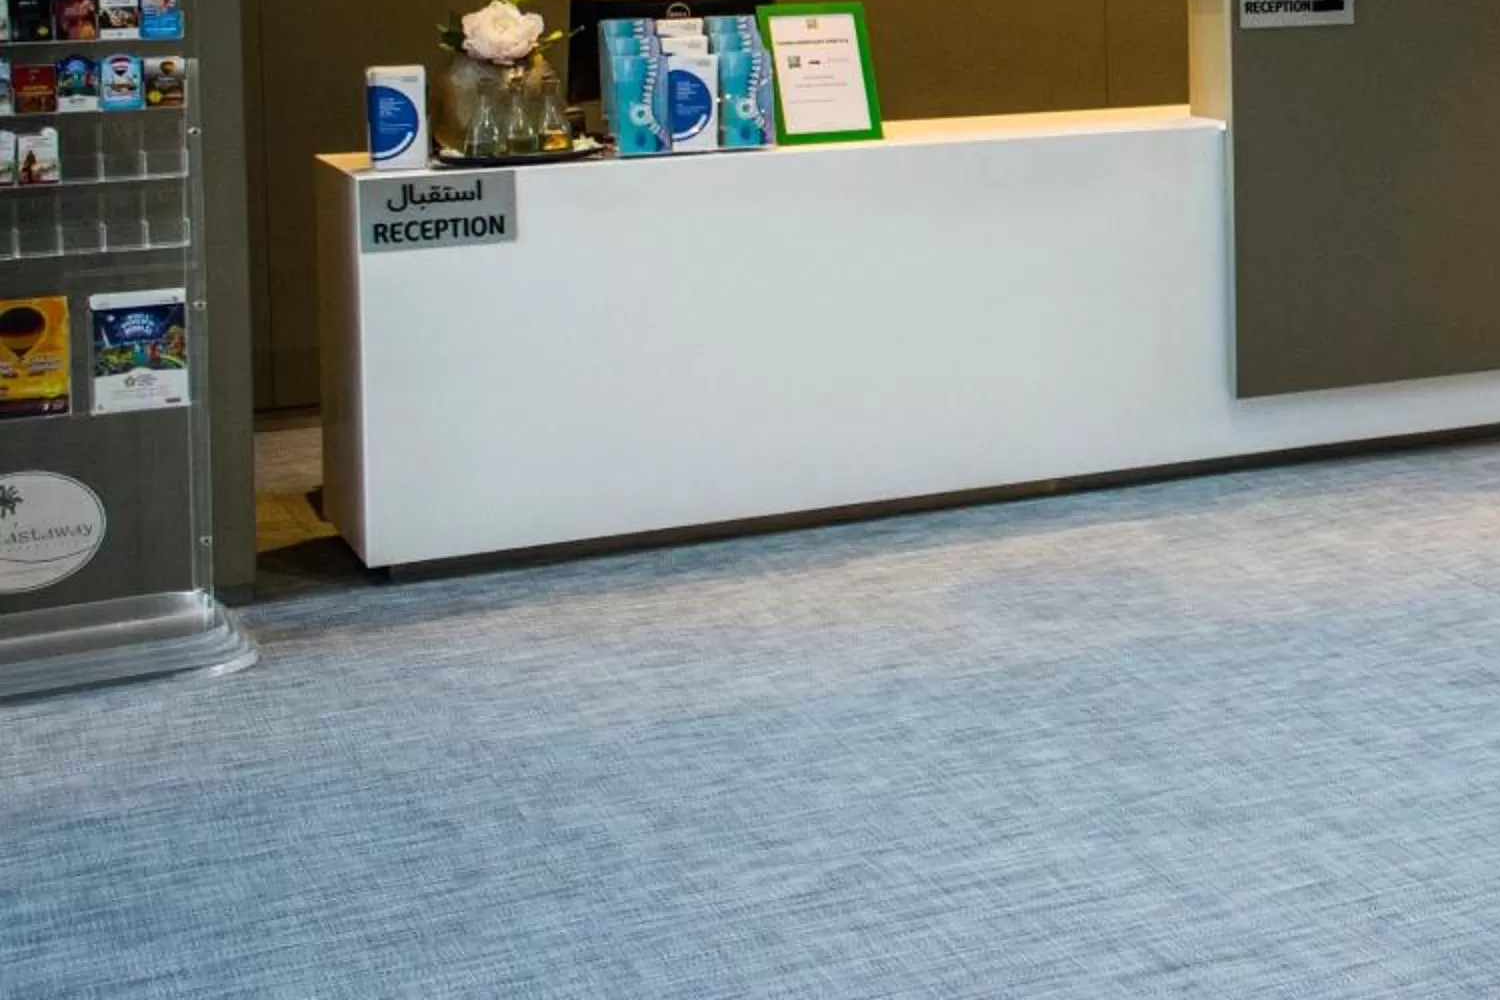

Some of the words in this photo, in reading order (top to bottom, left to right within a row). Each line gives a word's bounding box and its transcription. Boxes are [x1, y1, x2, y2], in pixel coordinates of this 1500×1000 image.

[1244, 0, 1312, 15] RECEPTION
[386, 179, 483, 213] استقبال
[373, 213, 506, 245] RECEPTION
[3, 523, 94, 546] astaway
